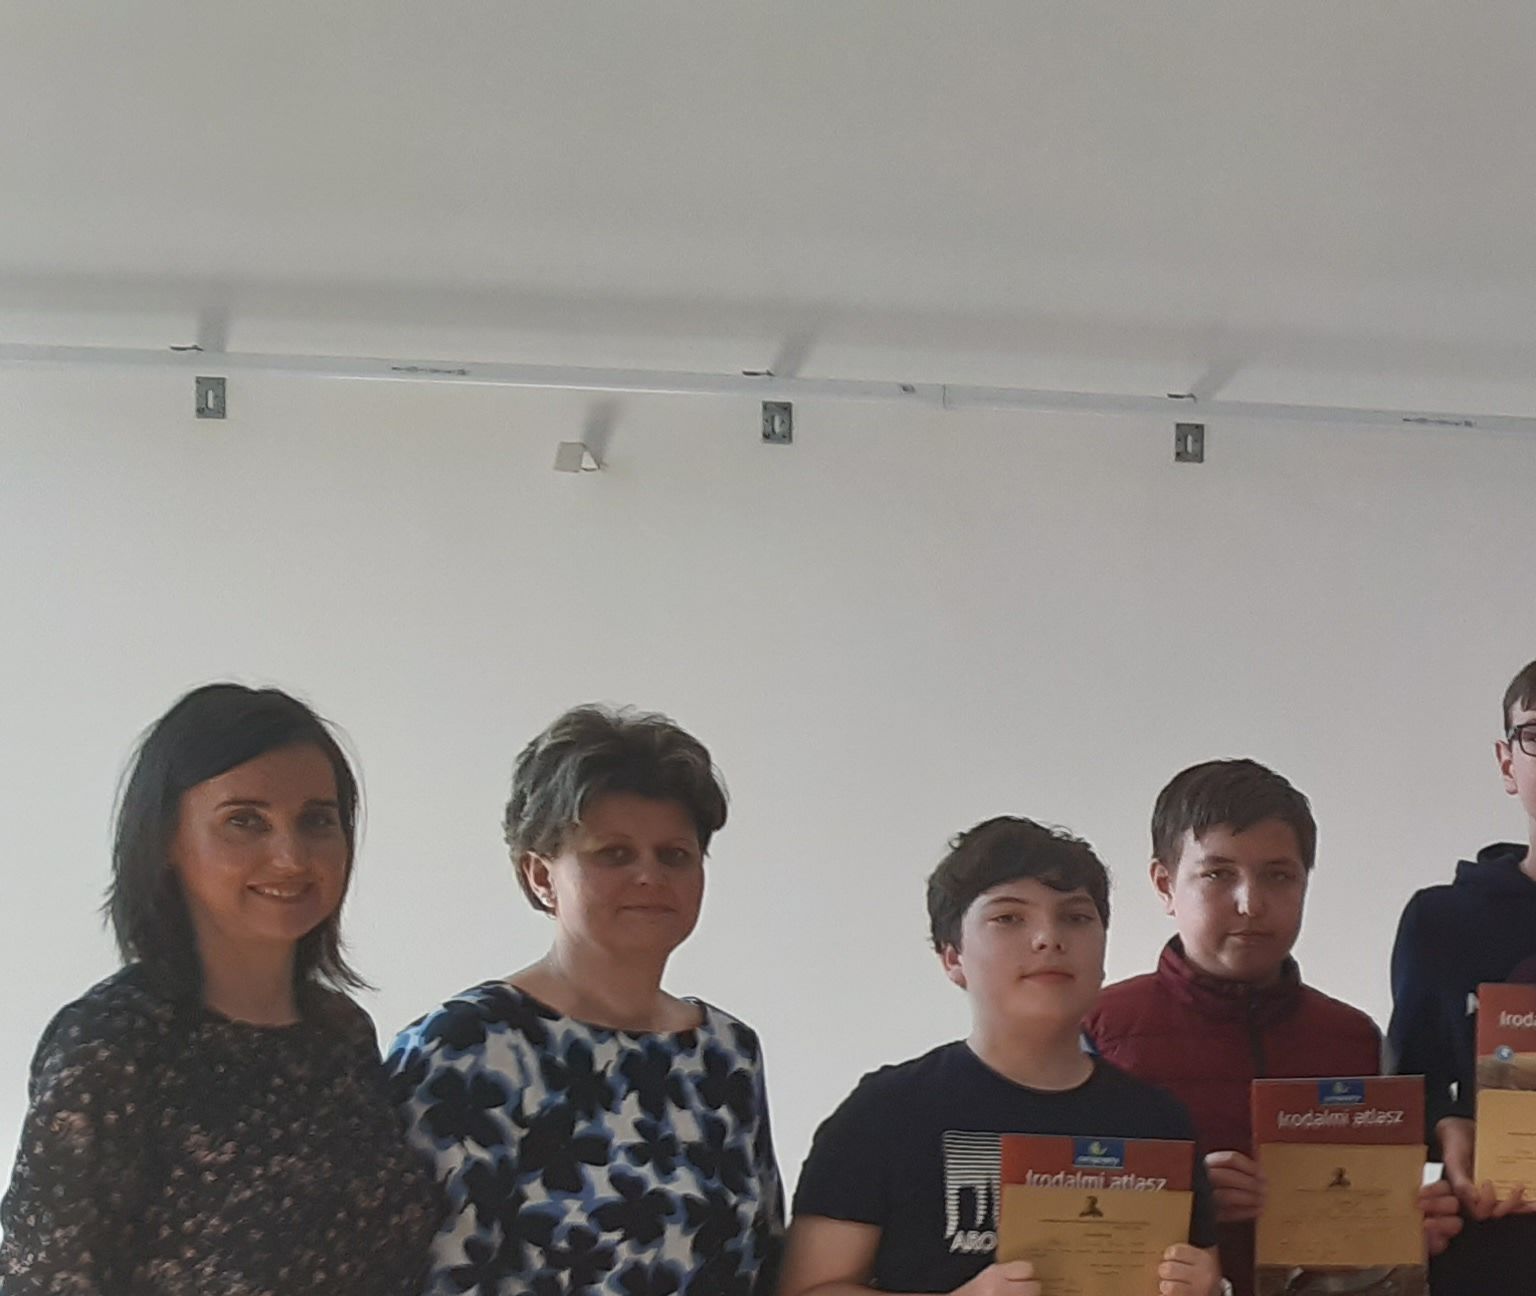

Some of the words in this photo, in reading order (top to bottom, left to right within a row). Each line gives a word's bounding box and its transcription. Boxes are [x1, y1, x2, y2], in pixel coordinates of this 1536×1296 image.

[1277, 1109, 1349, 1129] Irodalmi
[1353, 1108, 1404, 1127] atlasz
[1025, 1168, 1105, 1190] Irodalmi
[1109, 1172, 1168, 1192] atlasz
